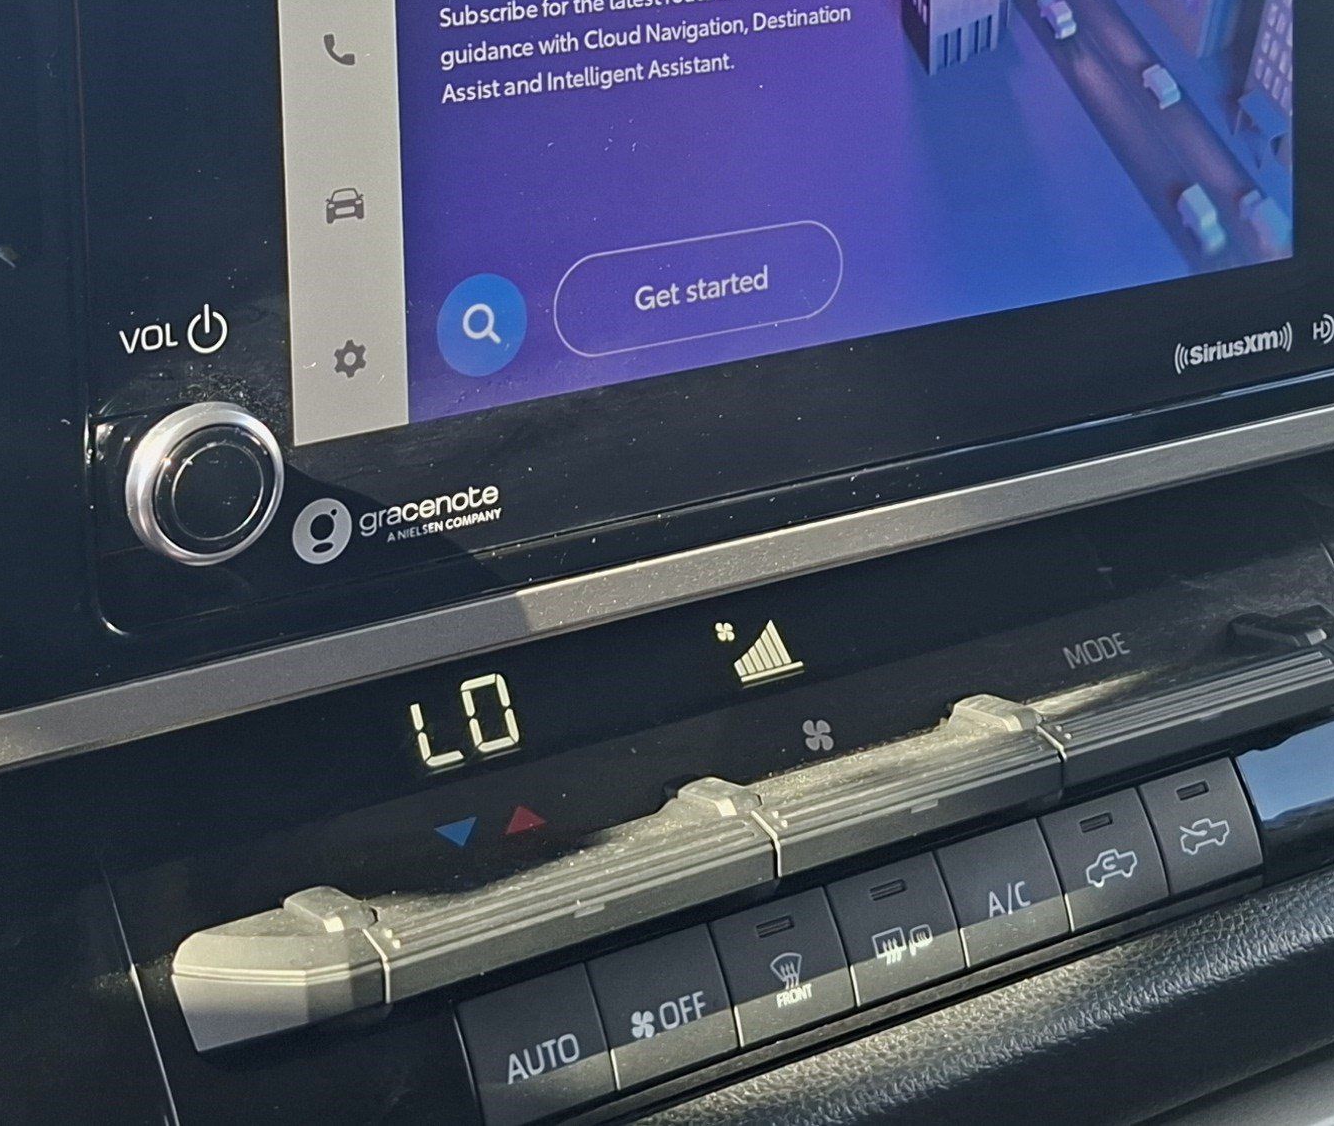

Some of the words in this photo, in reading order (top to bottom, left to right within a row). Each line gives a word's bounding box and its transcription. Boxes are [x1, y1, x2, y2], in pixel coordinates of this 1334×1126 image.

[439, 0, 538, 28] Subscribe
[440, 40, 534, 72] guidance
[538, 31, 579, 56] with
[584, 24, 641, 50] Cloud
[646, 16, 749, 44] Navigation,
[753, 5, 852, 32] Destination
[441, 79, 501, 104] Assist
[504, 72, 543, 96] and
[547, 62, 644, 90] Intelligent
[647, 53, 735, 80] Assistant.
[634, 282, 680, 311] Get
[686, 264, 769, 304] started
[118, 322, 179, 354] VOL
[359, 484, 499, 537] gracenote
[386, 531, 397, 543] A
[397, 519, 444, 541] NIELSEN
[445, 507, 503, 531] COMPANY
[1062, 632, 1131, 670] MODE
[987, 880, 1032, 918] A/C
[658, 990, 707, 1030] OFF
[775, 982, 814, 1009] FRONT
[507, 1032, 581, 1085] AUTO
